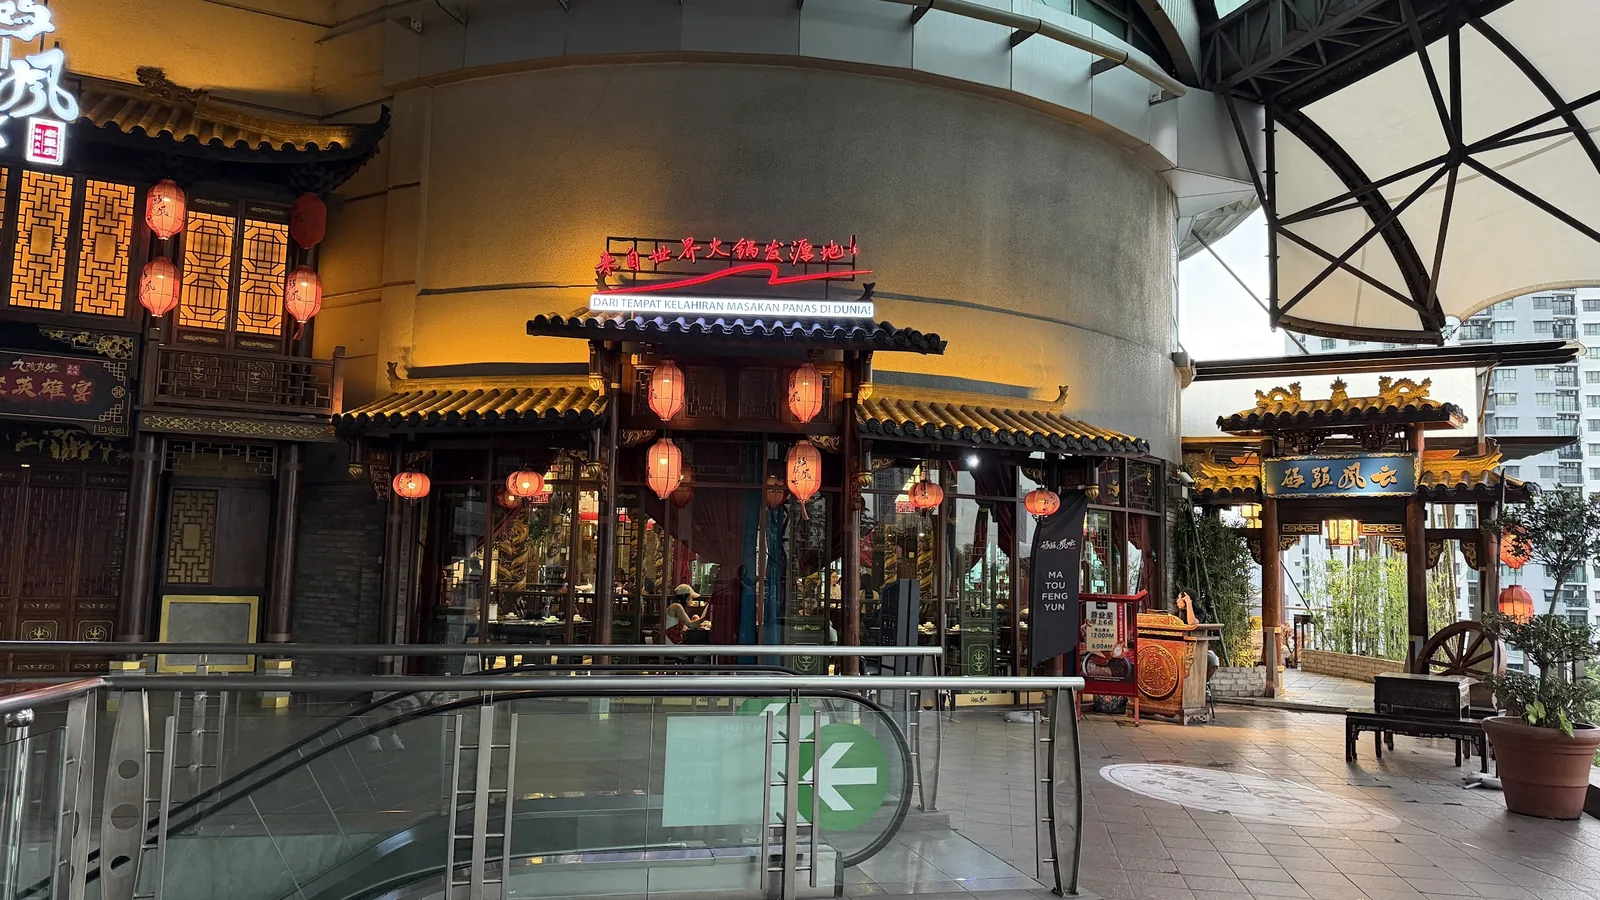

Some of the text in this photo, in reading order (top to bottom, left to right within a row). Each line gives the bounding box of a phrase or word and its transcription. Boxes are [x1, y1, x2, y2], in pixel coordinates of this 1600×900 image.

[593, 297, 871, 315] DARI TEMPAT KELAHIRAN MASAKAN PANAS DI DUNIA!
[0, 375, 92, 402] 英雄宴
[1048, 571, 1064, 579] MA
[1045, 581, 1066, 590] TOU
[1041, 592, 1069, 601] FENG
[1044, 603, 1065, 611] YUN
